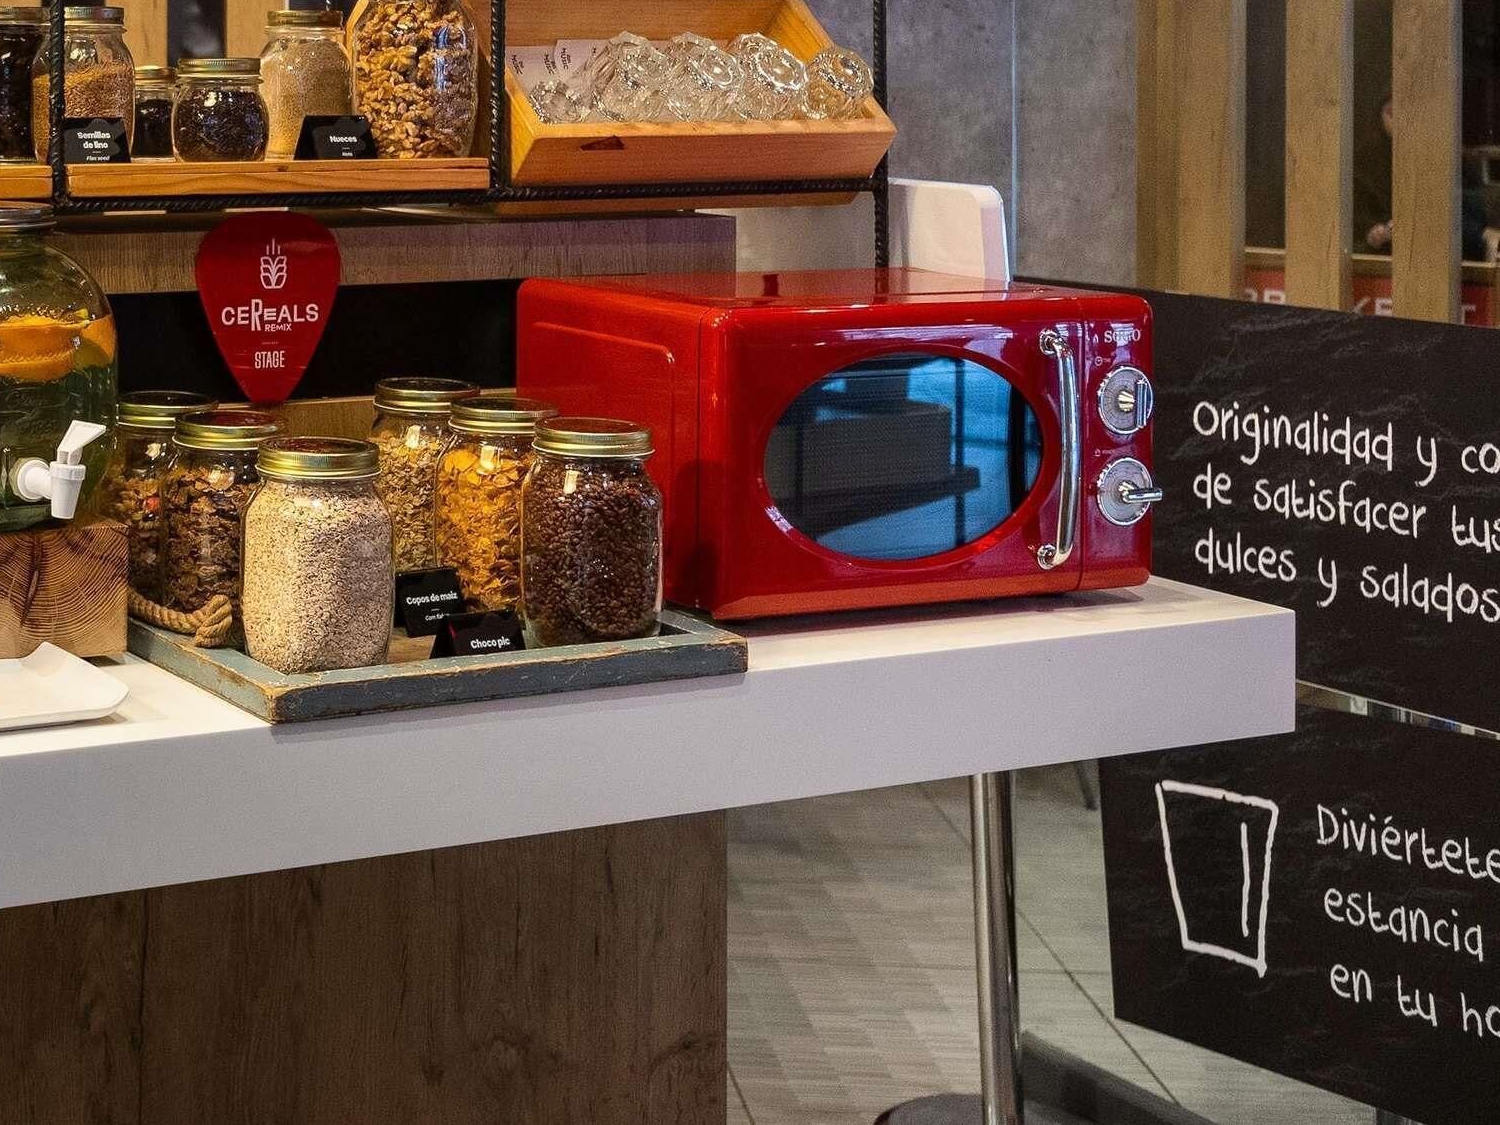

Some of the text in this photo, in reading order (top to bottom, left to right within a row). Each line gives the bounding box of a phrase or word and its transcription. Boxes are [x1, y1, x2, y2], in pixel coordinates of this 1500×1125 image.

[221, 299, 319, 332] CEREALS
[264, 323, 292, 332] REMIX
[254, 350, 285, 368] STAGE
[1193, 401, 1393, 471] Originalidad
[1414, 435, 1438, 487] y
[1193, 463, 1232, 509] de
[1253, 479, 1427, 539] satisfacer
[406, 596, 430, 606] Copos
[430, 593, 440, 602] de
[1194, 528, 1500, 623] dulces y salados
[470, 638, 497, 649] Choco
[1317, 804, 1500, 883] Diviértete
[1324, 888, 1483, 962] estancia
[1330, 964, 1372, 1003] en
[1397, 975, 1438, 1026] tu
